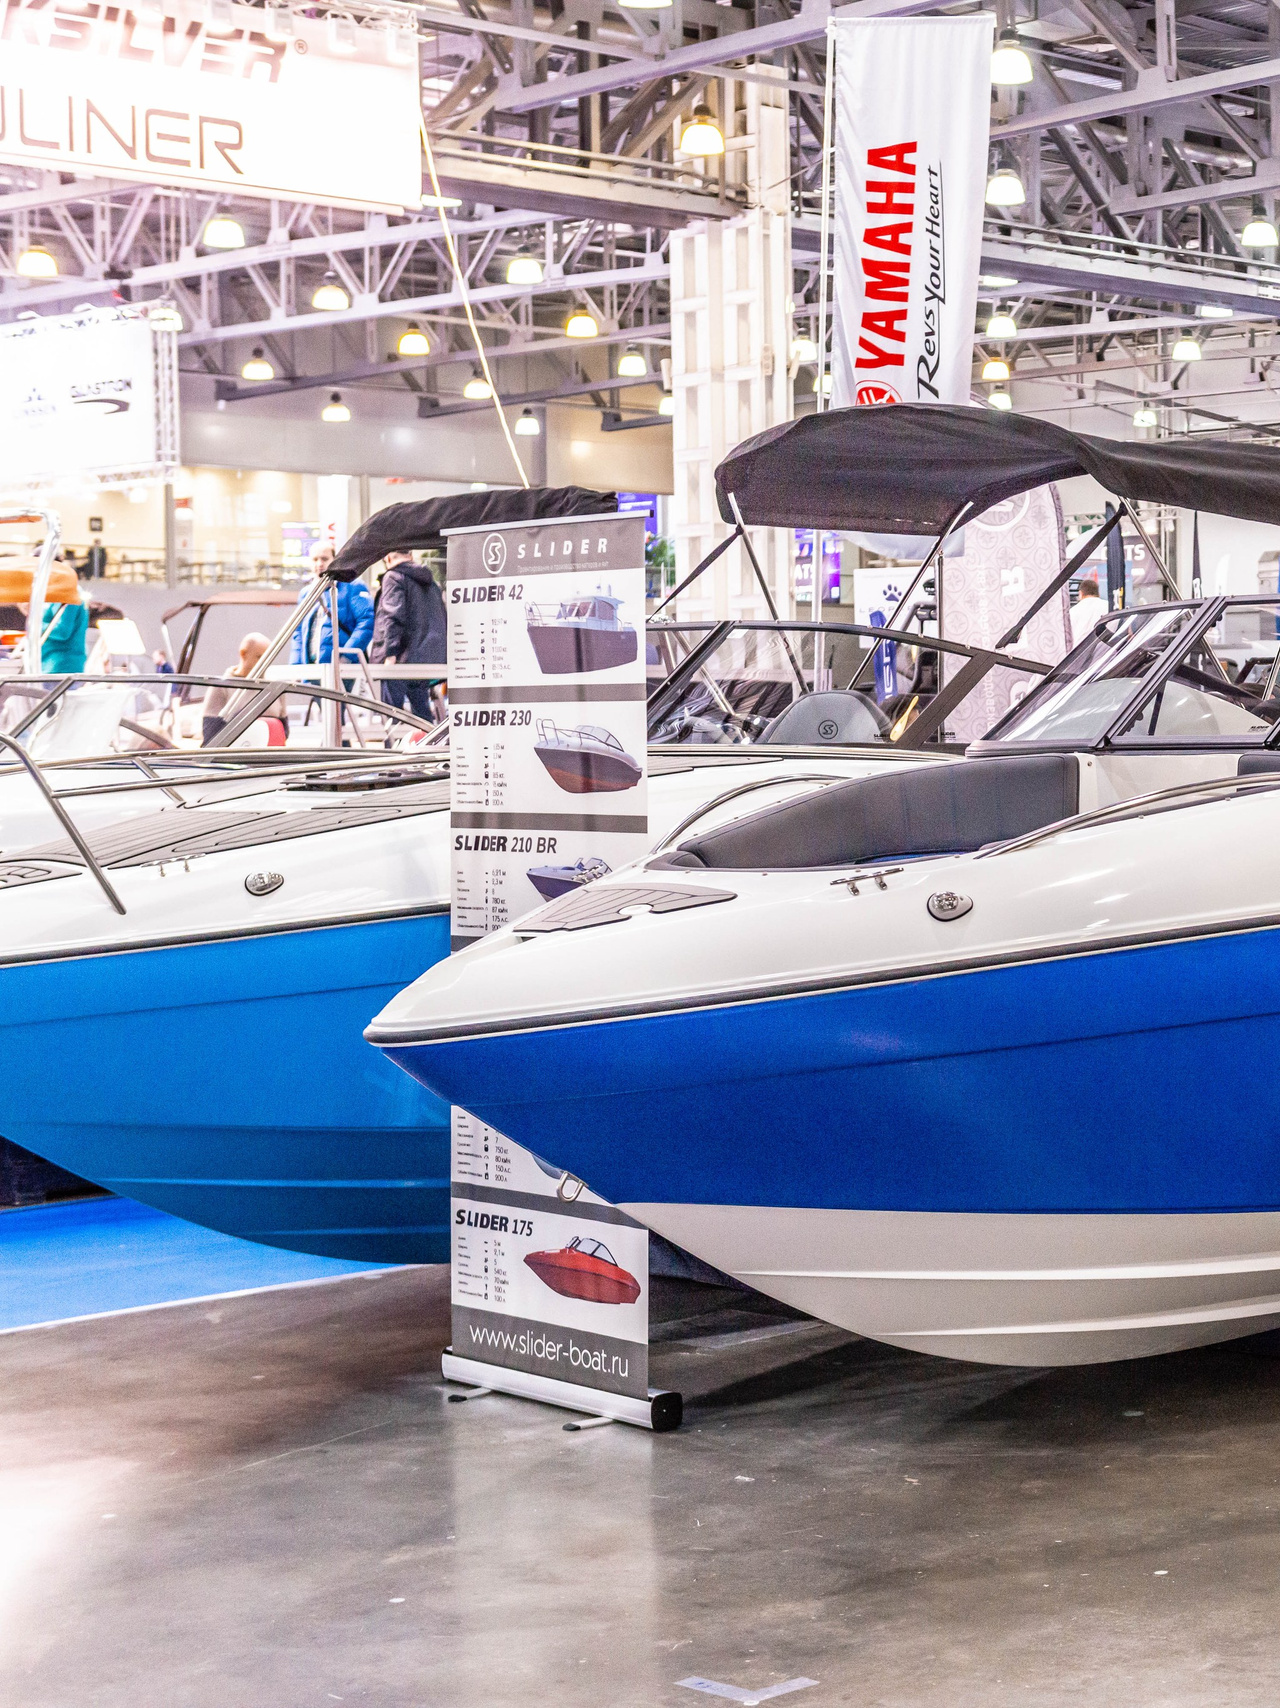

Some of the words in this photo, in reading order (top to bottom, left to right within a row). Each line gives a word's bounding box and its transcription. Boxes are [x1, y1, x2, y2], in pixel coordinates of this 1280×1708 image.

[925, 163, 942, 241] Heart
[855, 141, 918, 369] YAMAHA
[924, 240, 945, 305] Your
[917, 305, 940, 400] Revs
[517, 538, 608, 559] SLIDER
[451, 584, 505, 604] SLIDER
[509, 584, 524, 600] 42
[454, 710, 506, 726] SLIDER
[510, 710, 532, 726] 230
[455, 835, 508, 851] SLIDER
[511, 837, 532, 853] 210
[536, 837, 557, 853] BR
[455, 1209, 509, 1232] SLIDER
[512, 1218, 533, 1237] 175
[469, 1325, 629, 1377] www.slider-boat.ru
